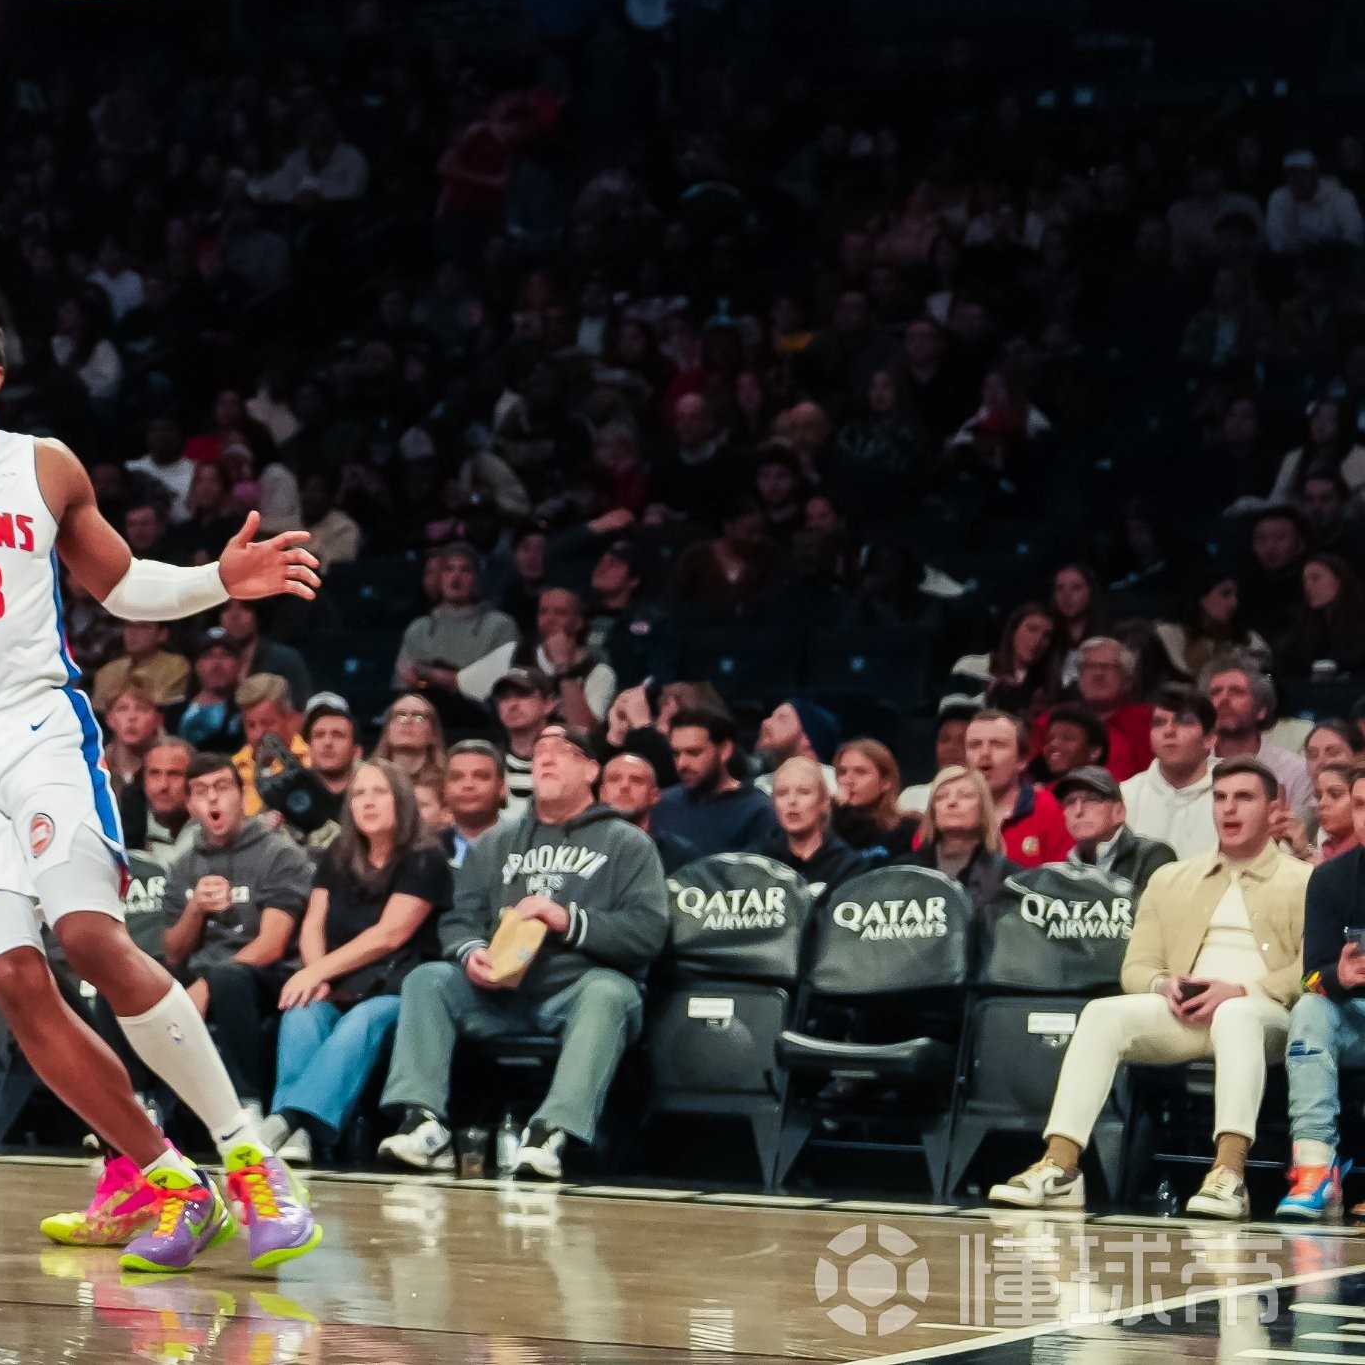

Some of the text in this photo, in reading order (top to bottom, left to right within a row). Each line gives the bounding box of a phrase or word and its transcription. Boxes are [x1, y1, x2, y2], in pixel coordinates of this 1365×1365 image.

[677, 886, 787, 920] QATAR
[833, 896, 948, 932] QATAR
[1020, 893, 1133, 928] QATAR
[701, 911, 787, 931] AIRWAYS
[859, 920, 948, 941] AIRWAYS
